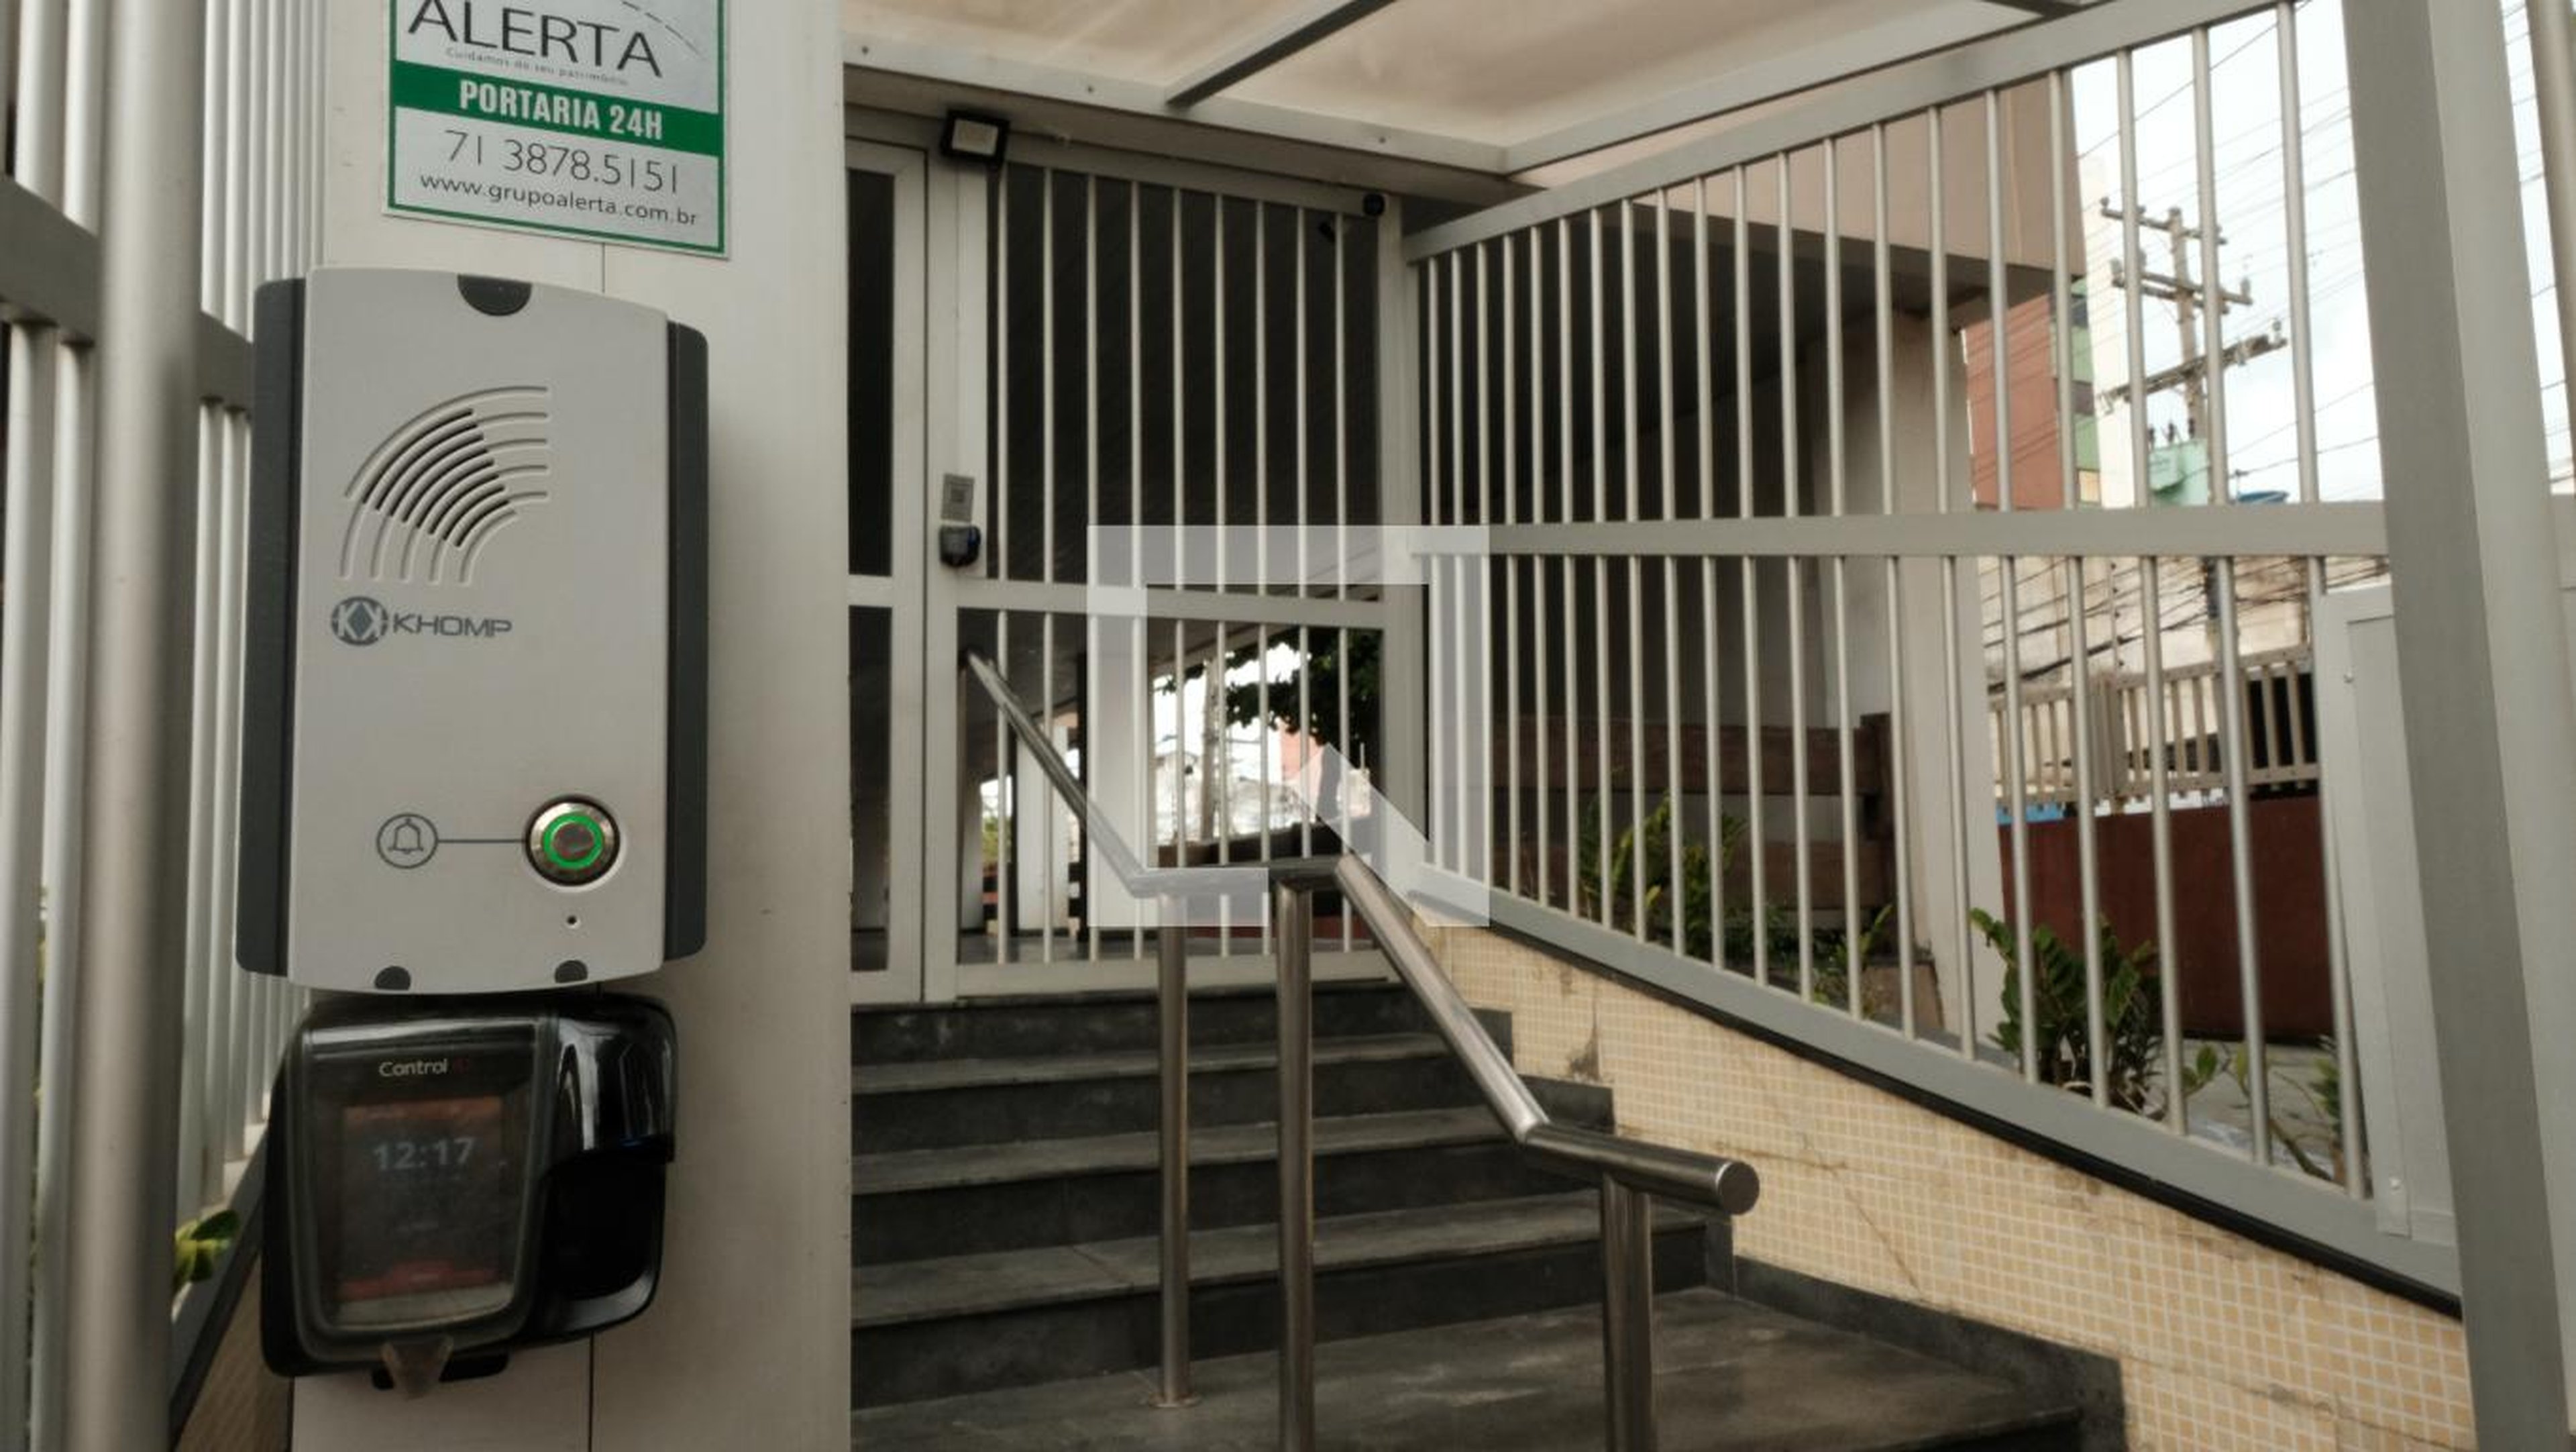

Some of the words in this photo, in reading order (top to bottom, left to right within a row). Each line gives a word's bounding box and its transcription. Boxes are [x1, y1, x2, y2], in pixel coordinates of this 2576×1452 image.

[408, 0, 661, 78] ALERTA
[460, 79, 600, 130] PORTARIA
[610, 105, 663, 140] 24H
[445, 129, 482, 165] 71
[504, 139, 678, 194] 3878.5151
[421, 174, 697, 225] www.grupoalerta.com.br
[393, 613, 512, 637] KHOMP
[380, 1058, 448, 1077] Control
[374, 1138, 475, 1170] 12:17
